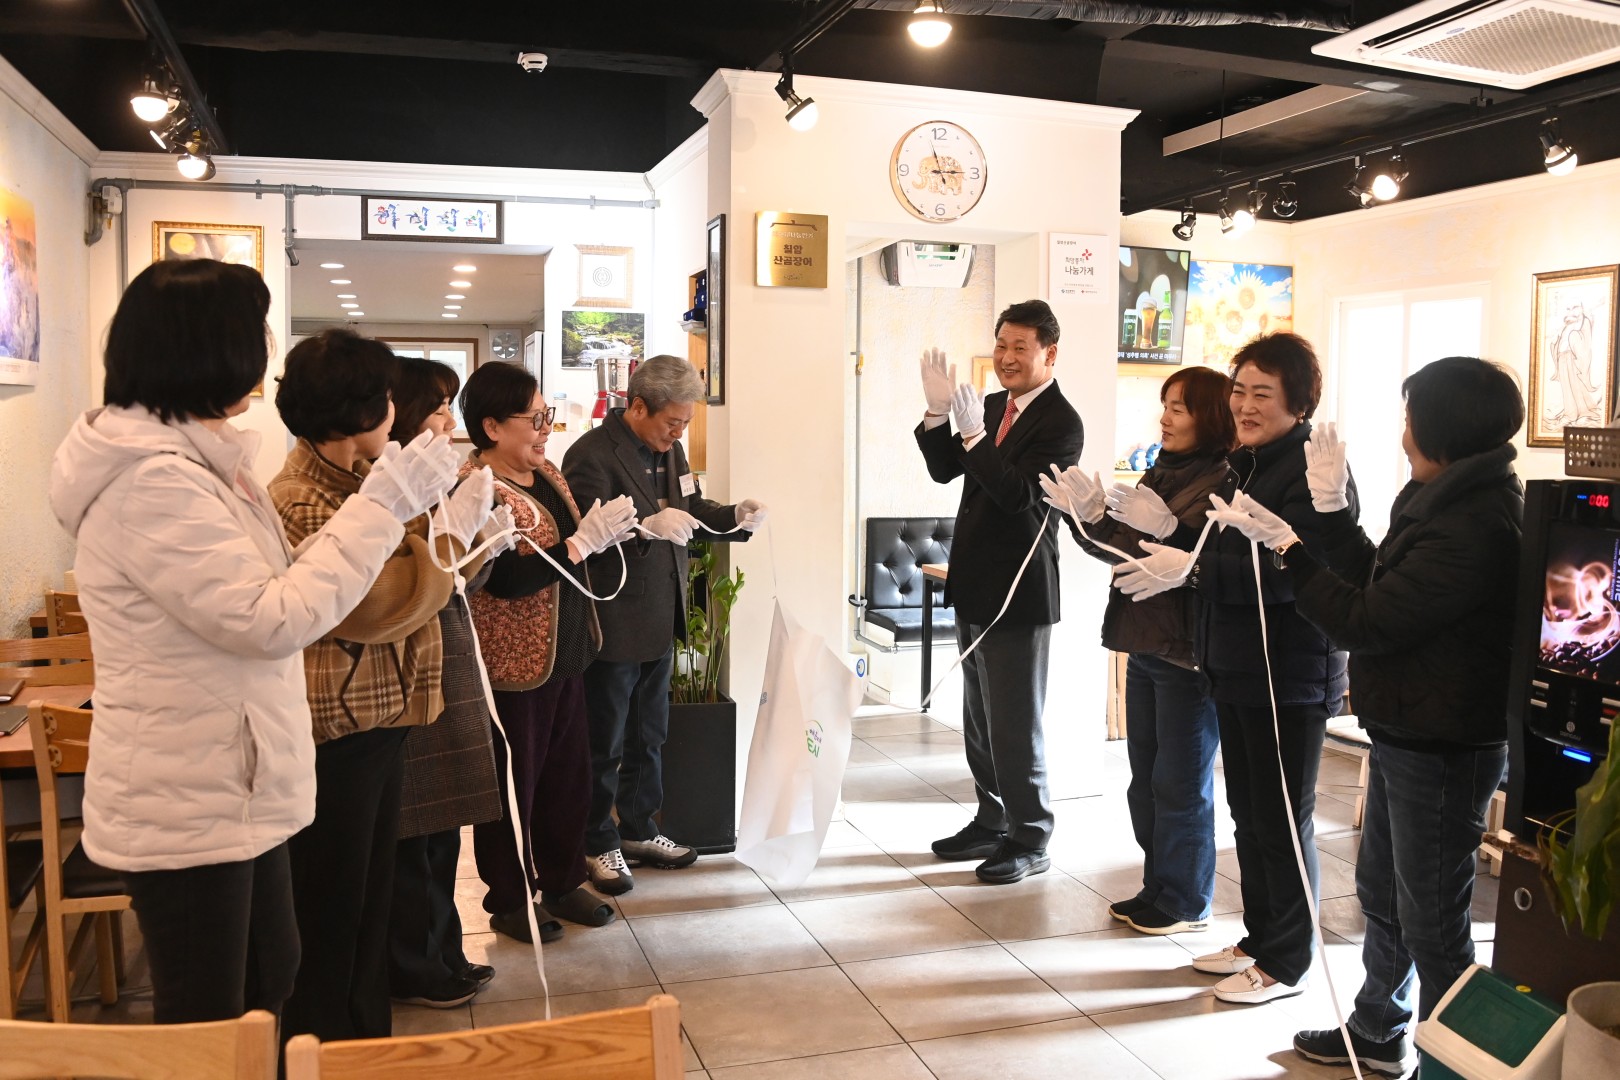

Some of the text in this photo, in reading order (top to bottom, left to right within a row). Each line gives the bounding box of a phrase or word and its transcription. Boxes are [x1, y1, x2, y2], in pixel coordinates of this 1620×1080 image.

[931, 127, 948, 141] 12
[899, 163, 910, 177] 9
[969, 167, 980, 180] 3
[935, 203, 946, 216] 6
[773, 256, 813, 267] 산곰장어
[1065, 265, 1094, 276] 나눔가게
